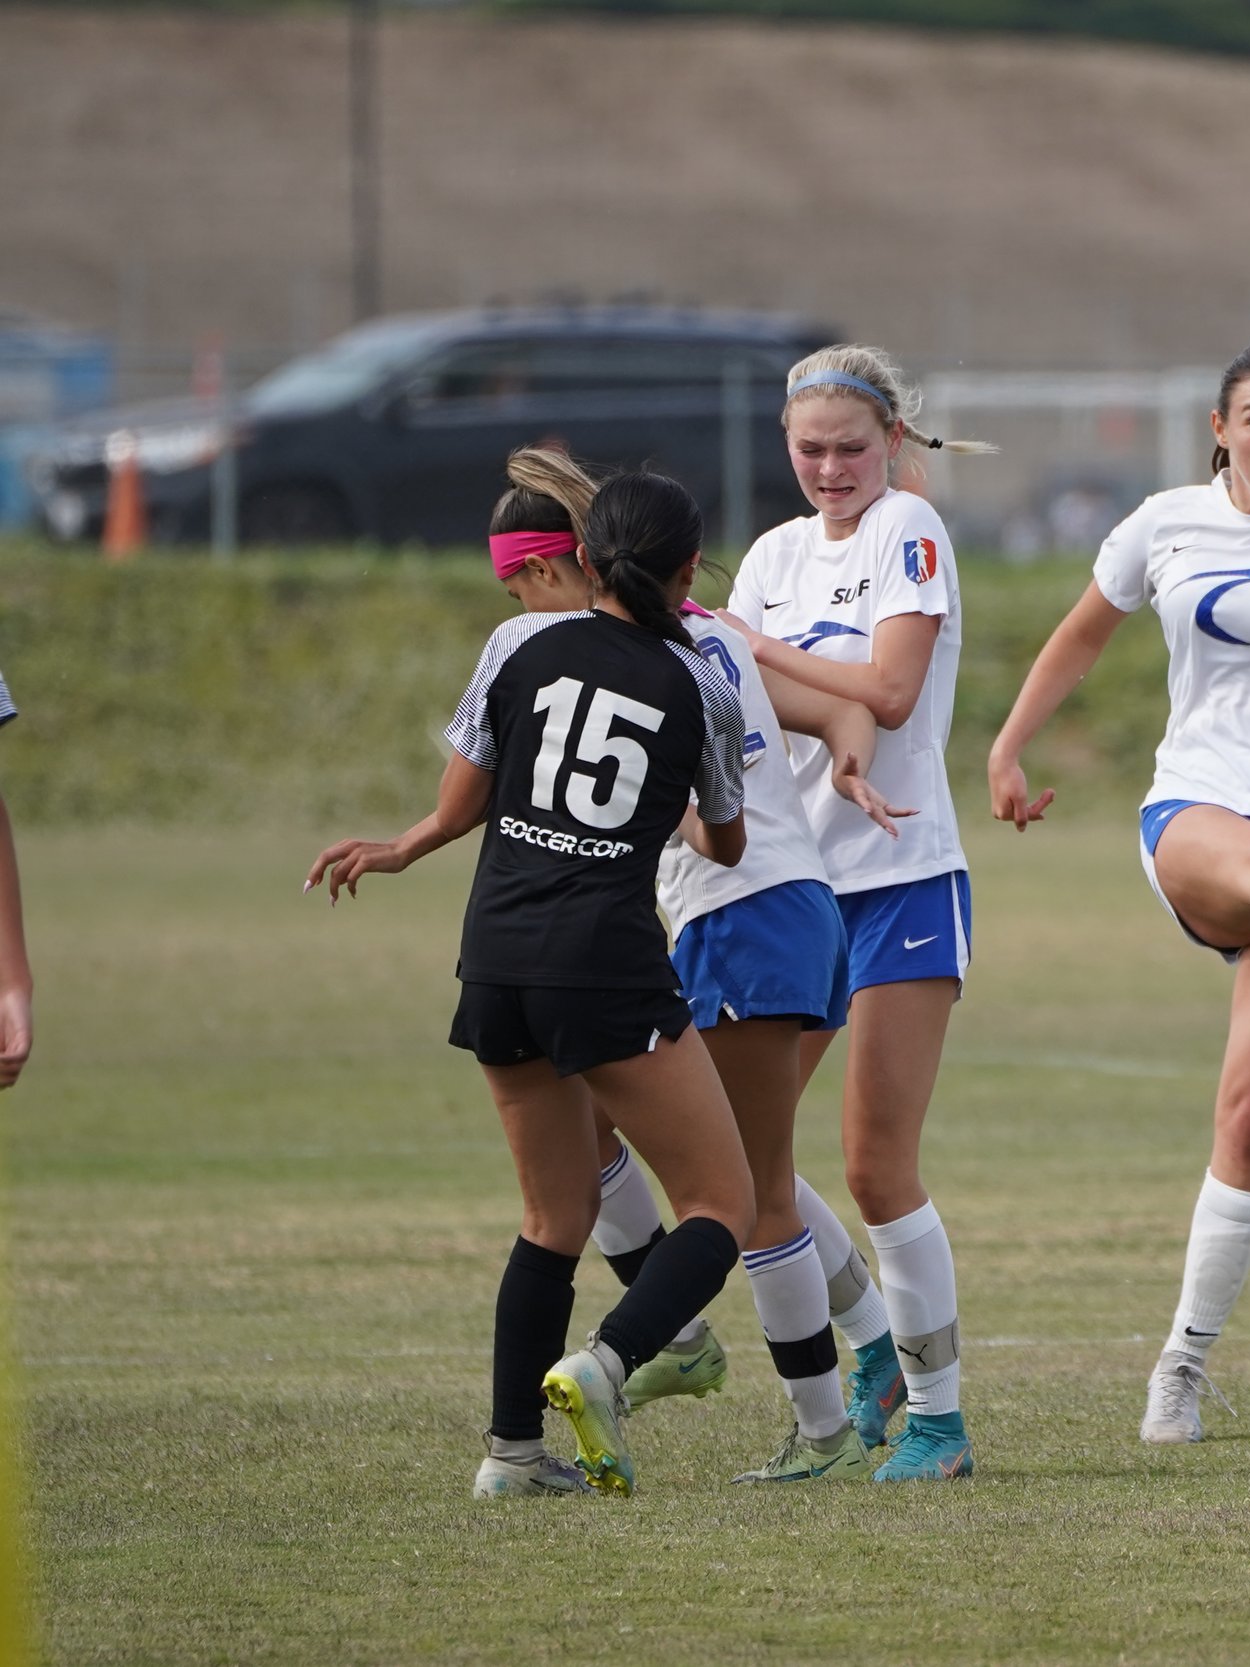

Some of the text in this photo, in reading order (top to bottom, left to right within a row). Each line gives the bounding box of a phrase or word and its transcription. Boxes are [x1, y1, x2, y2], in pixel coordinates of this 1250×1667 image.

[830, 578, 871, 605] SUF
[531, 676, 666, 830] 15
[499, 816, 635, 859] SOCCER.COM
